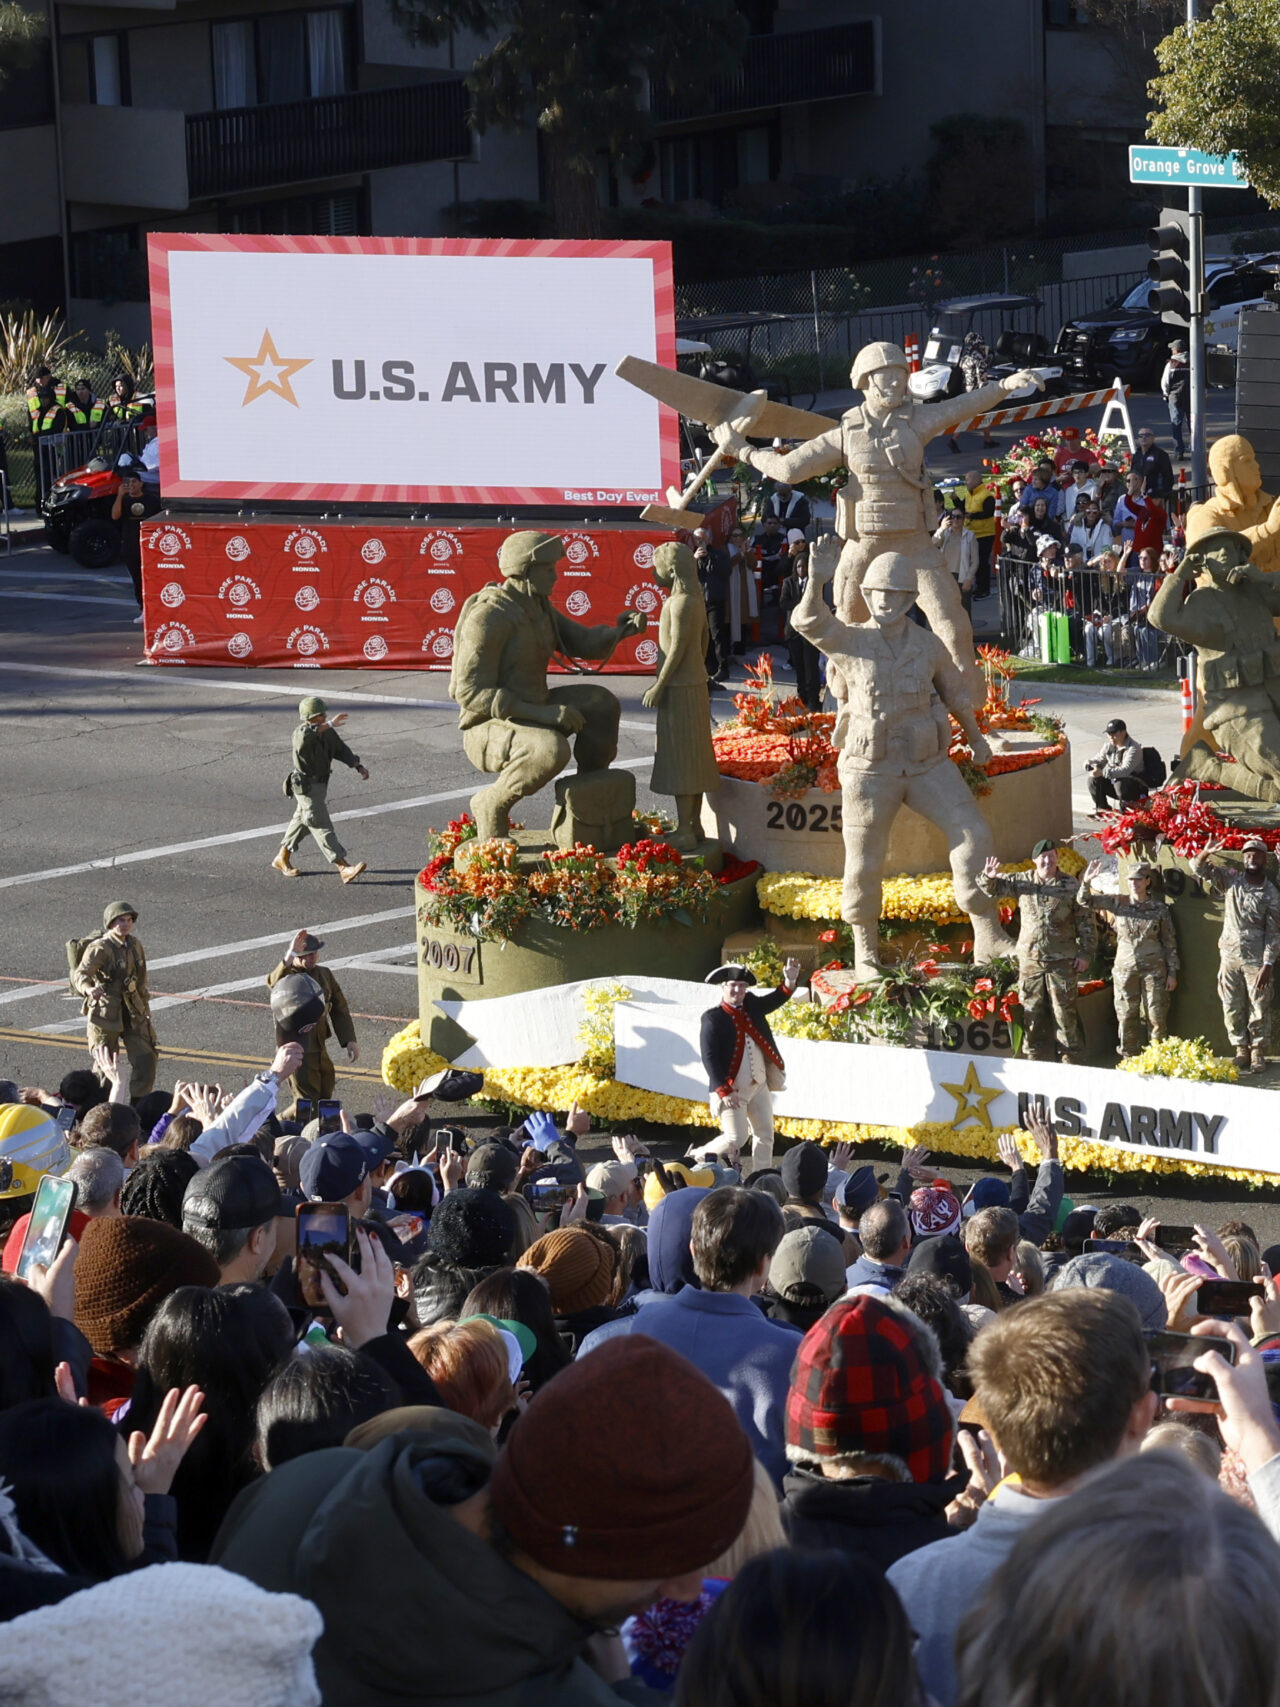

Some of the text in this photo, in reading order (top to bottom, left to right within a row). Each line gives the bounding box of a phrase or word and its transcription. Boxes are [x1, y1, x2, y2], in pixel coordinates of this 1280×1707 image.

[1133, 157, 1180, 177] Orange
[1186, 159, 1225, 176] Grove
[331, 358, 608, 404] U.S. ARMY
[564, 490, 659, 504] Best Day Ever!
[149, 525, 192, 550] ROSE PARADE
[284, 528, 328, 553] ROSE PARADE
[419, 530, 463, 555] ROSE PARADE
[572, 532, 600, 558] PARADE
[218, 575, 262, 600] ROSE PARADE
[353, 577, 397, 602] ROSE PARADE
[624, 582, 667, 606] ROSE PARAD
[169, 621, 196, 647] PARADE
[286, 624, 330, 650] ROSE PARADE
[421, 629, 437, 652] ROSE
[421, 936, 475, 974] 2007
[922, 1020, 1012, 1051] 1965
[1099, 1102, 1225, 1153] ARMY
